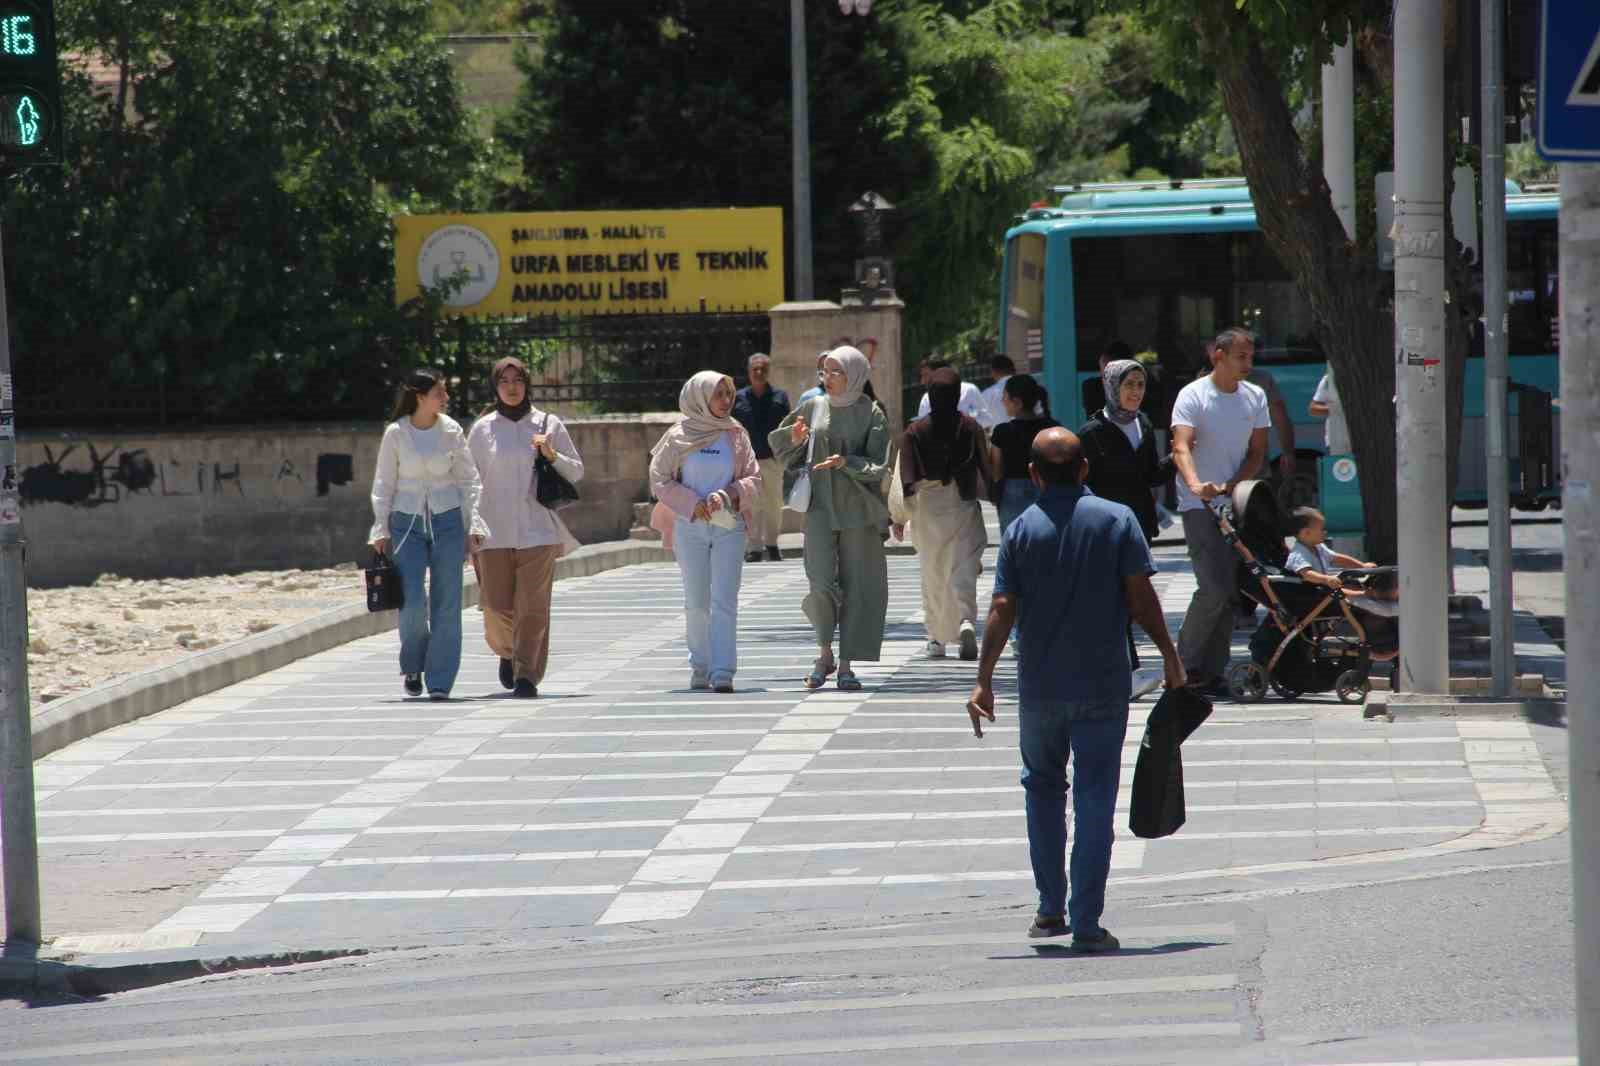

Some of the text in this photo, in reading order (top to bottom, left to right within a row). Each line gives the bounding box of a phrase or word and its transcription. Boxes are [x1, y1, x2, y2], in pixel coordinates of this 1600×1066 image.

[2, 16, 35, 54] 16
[511, 227, 589, 244] ŞANLIURFA
[511, 248, 768, 273] URFA MESLEKİ VE TEKNİK
[511, 276, 668, 302] ANADOLU LİSESİ
